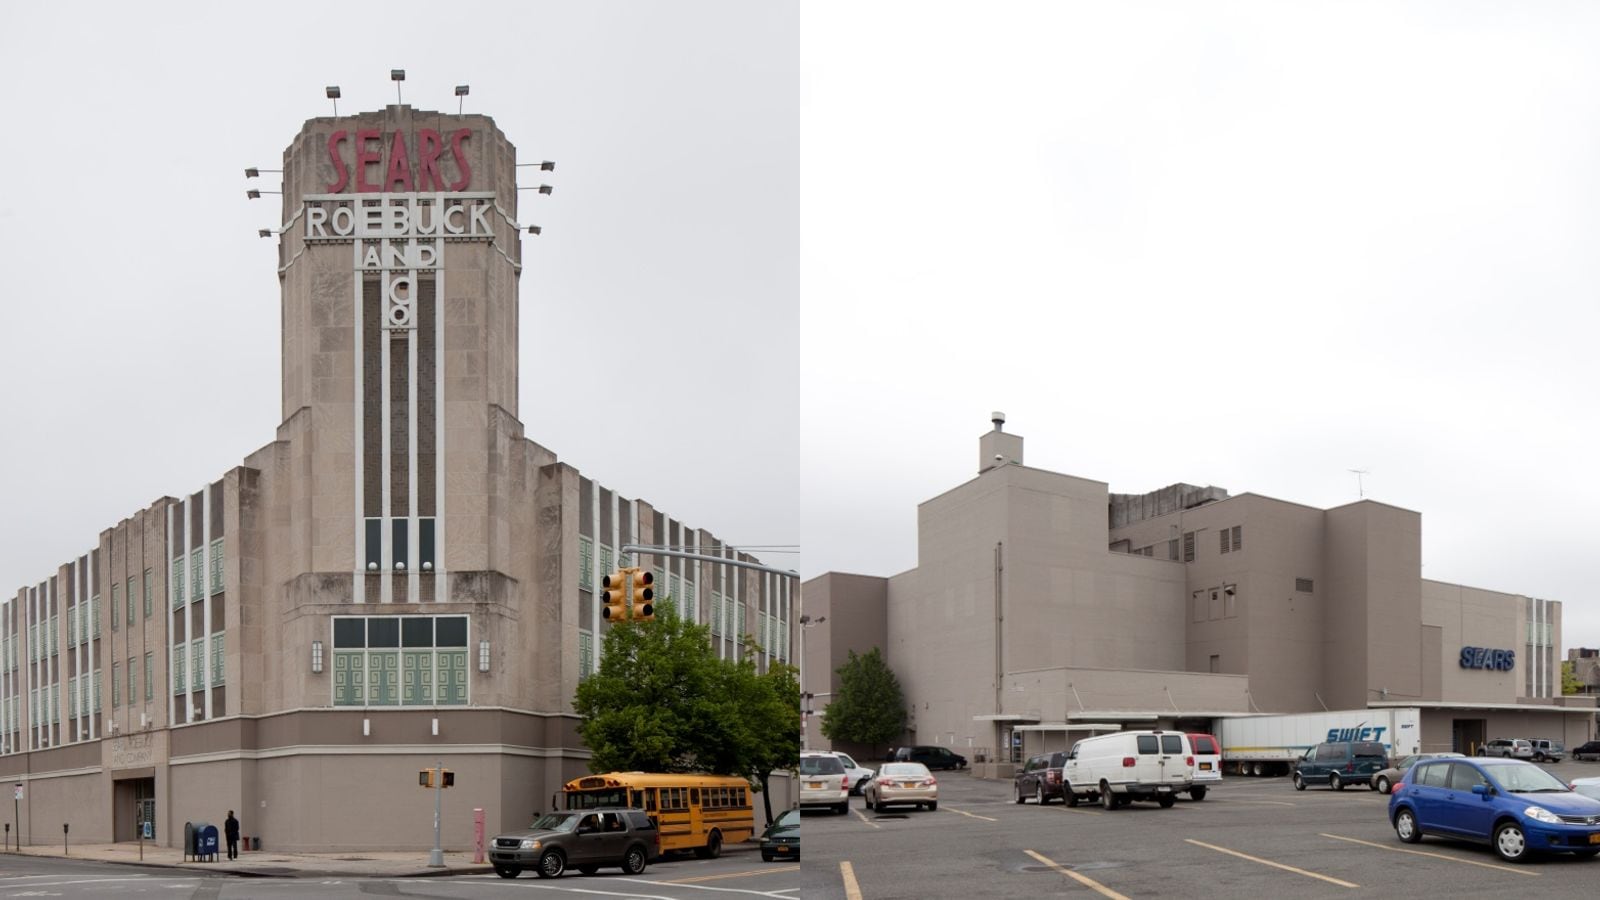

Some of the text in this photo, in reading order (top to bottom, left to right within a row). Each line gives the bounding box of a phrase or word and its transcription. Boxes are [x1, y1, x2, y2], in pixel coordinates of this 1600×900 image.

[327, 128, 471, 192] SEARS
[307, 205, 493, 236] ROEBUCK
[362, 245, 437, 267] AND
[388, 276, 410, 325] CO
[1459, 646, 1515, 671] SEARS
[1327, 724, 1386, 743] SWIFT
